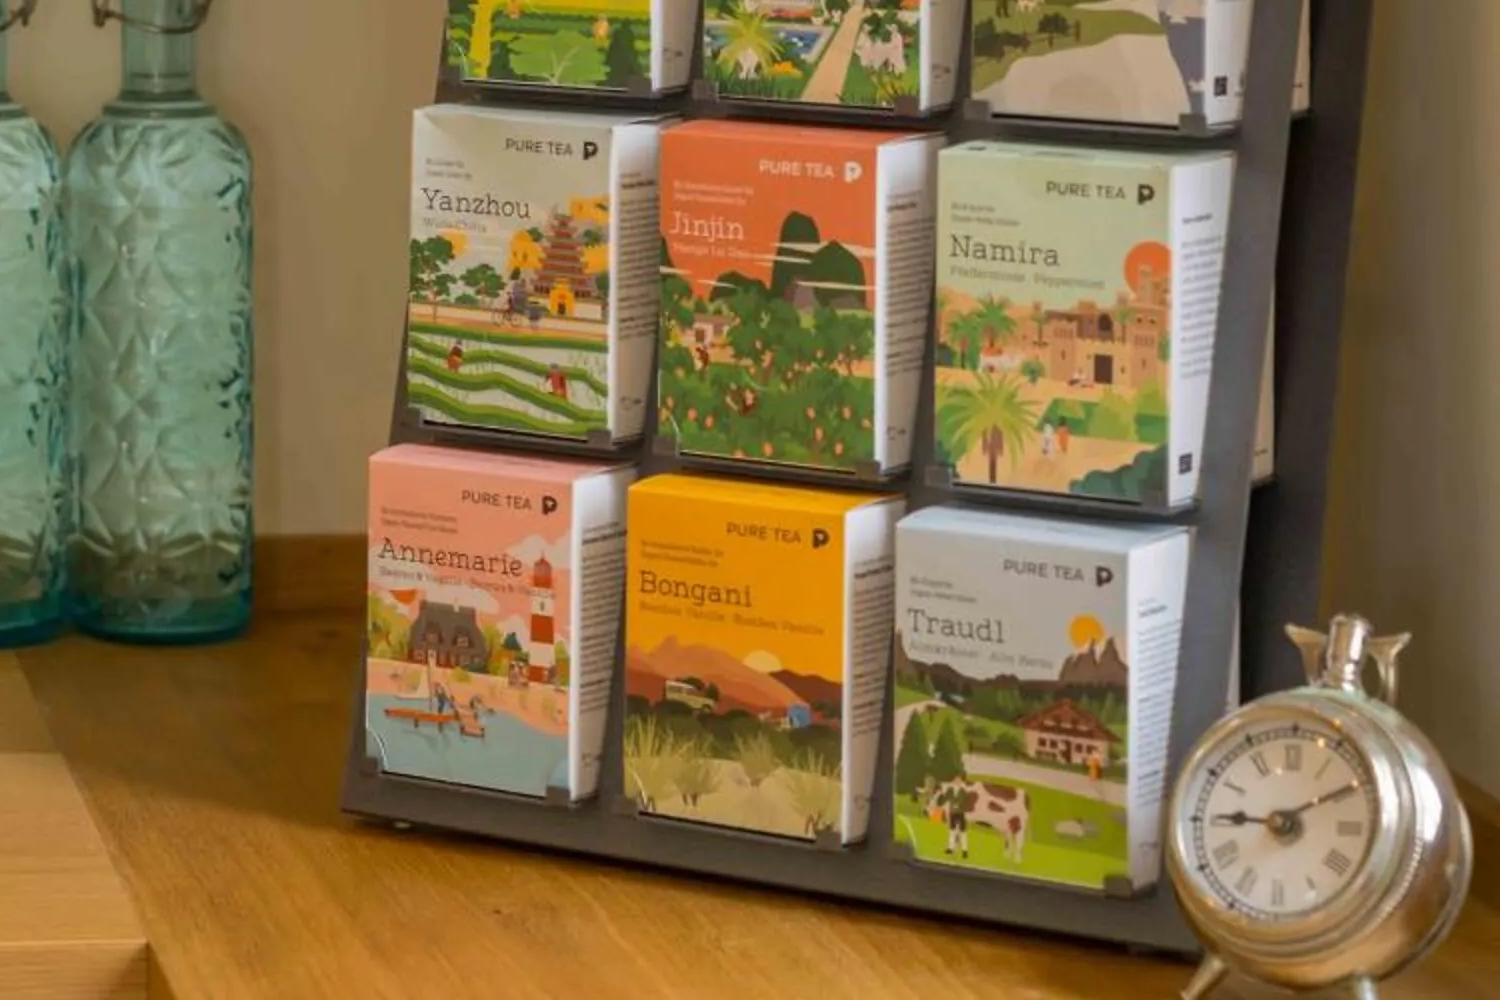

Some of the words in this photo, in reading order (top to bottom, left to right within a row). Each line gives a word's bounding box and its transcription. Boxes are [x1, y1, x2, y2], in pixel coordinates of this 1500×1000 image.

[504, 137, 543, 154] PURE
[547, 140, 574, 157] TEA
[758, 158, 802, 177] PURE
[804, 161, 837, 180] TEA
[420, 186, 532, 221] Yanzhou
[1045, 180, 1090, 198] PURE
[1095, 183, 1127, 201] TEA
[668, 209, 745, 243] Jinjin
[948, 233, 1061, 267] Namira
[460, 489, 501, 507] PURE
[506, 494, 534, 511] TEA
[726, 520, 767, 541] PURE
[772, 525, 803, 544] TEA
[377, 536, 524, 578] Annemarie
[1002, 557, 1049, 580] PURE
[1052, 563, 1086, 583] TEA
[639, 569, 753, 608] Bongani
[906, 607, 1005, 645] Traudl
